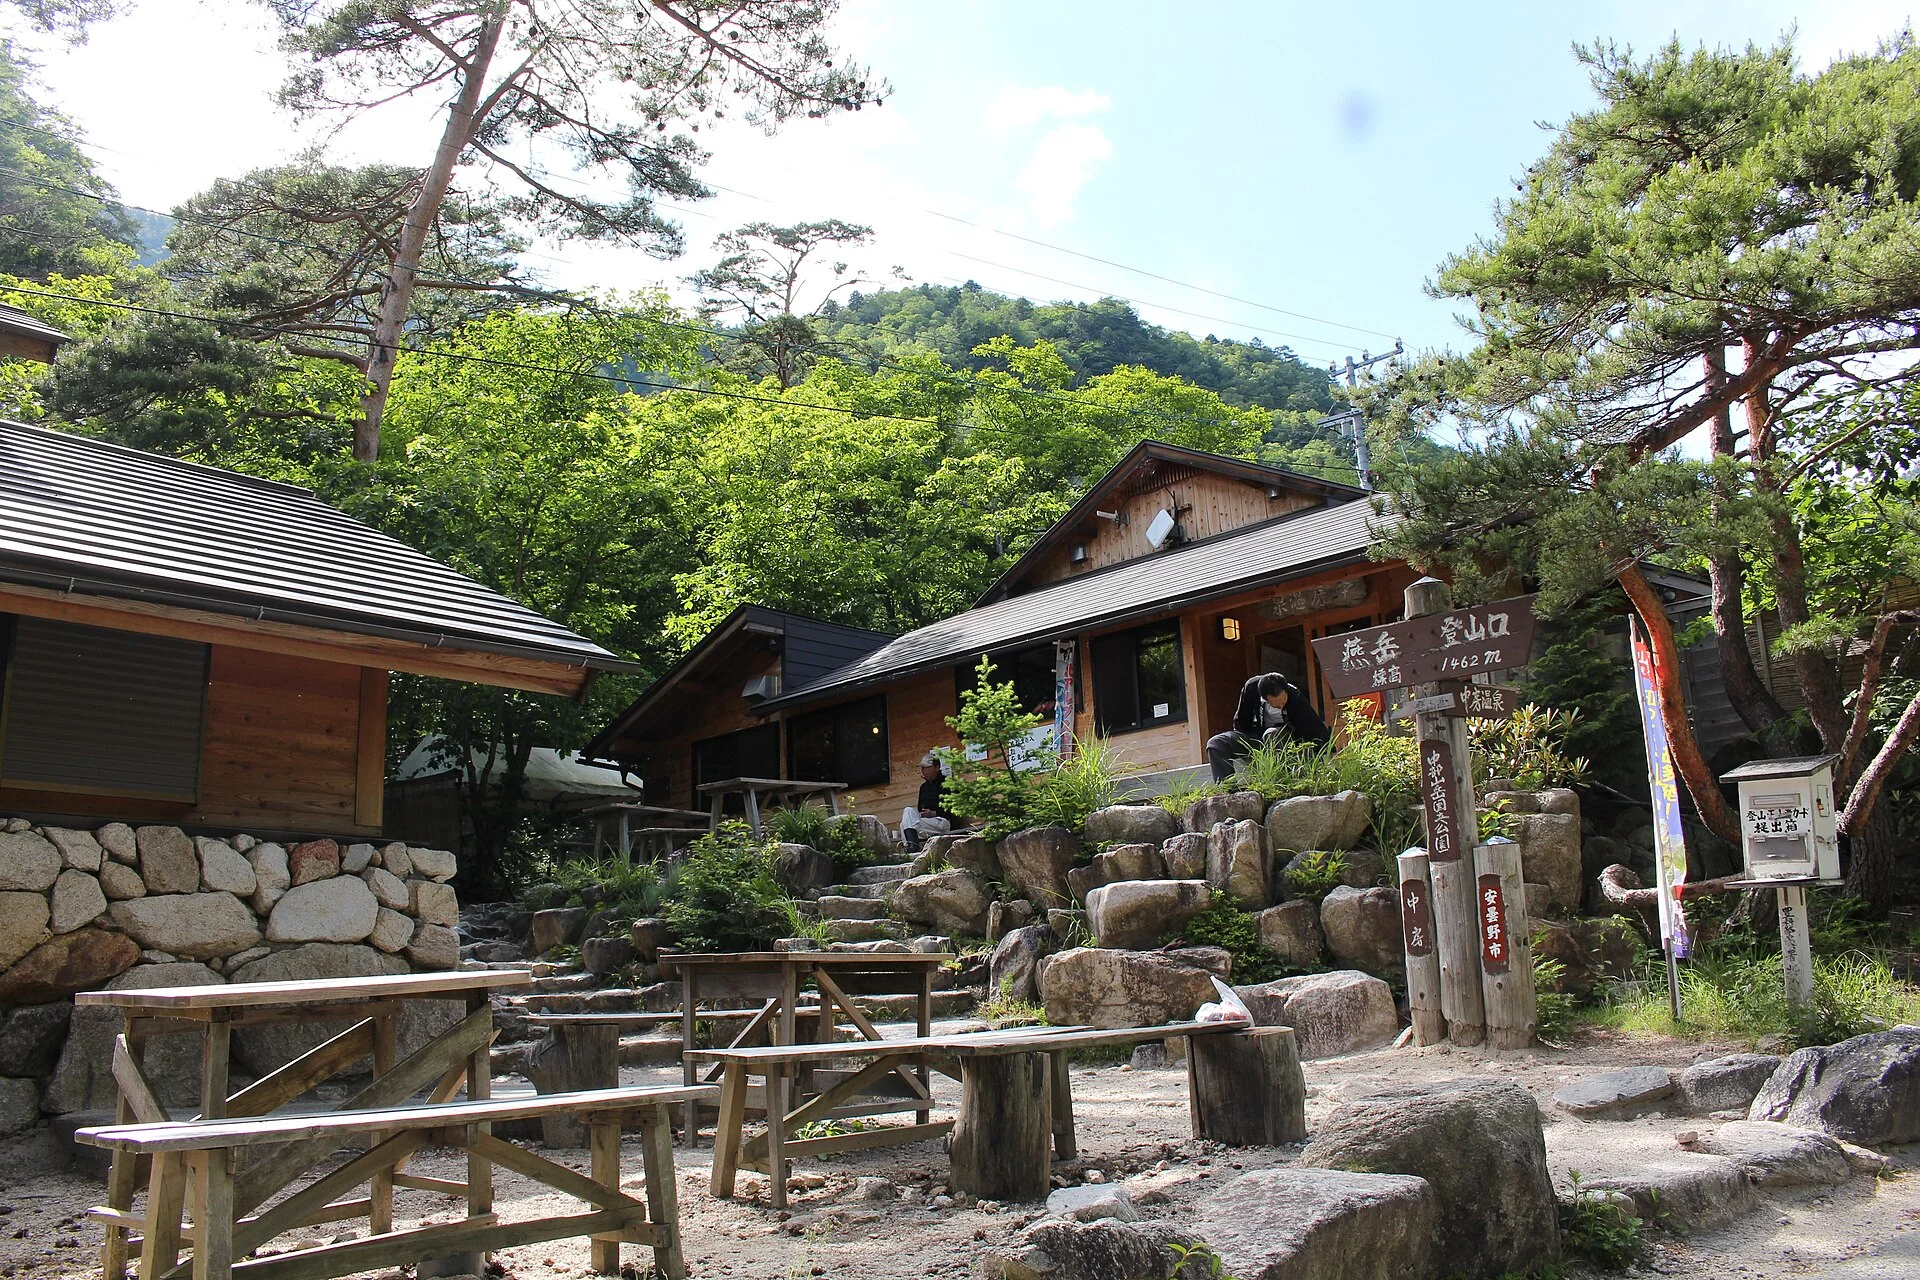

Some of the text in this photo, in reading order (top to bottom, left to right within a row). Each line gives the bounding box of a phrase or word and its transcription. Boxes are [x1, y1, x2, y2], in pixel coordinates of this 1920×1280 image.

[1341, 612, 1511, 673] 燕岳 登山口
[1371, 664, 1402, 688] 標高
[1442, 654, 1479, 672] 1462
[1460, 685, 1505, 714] 中房温泉
[1753, 818, 1798, 833] 提出箱
[1406, 891, 1424, 948] 中房
[1483, 888, 1502, 959] 安曇野市
